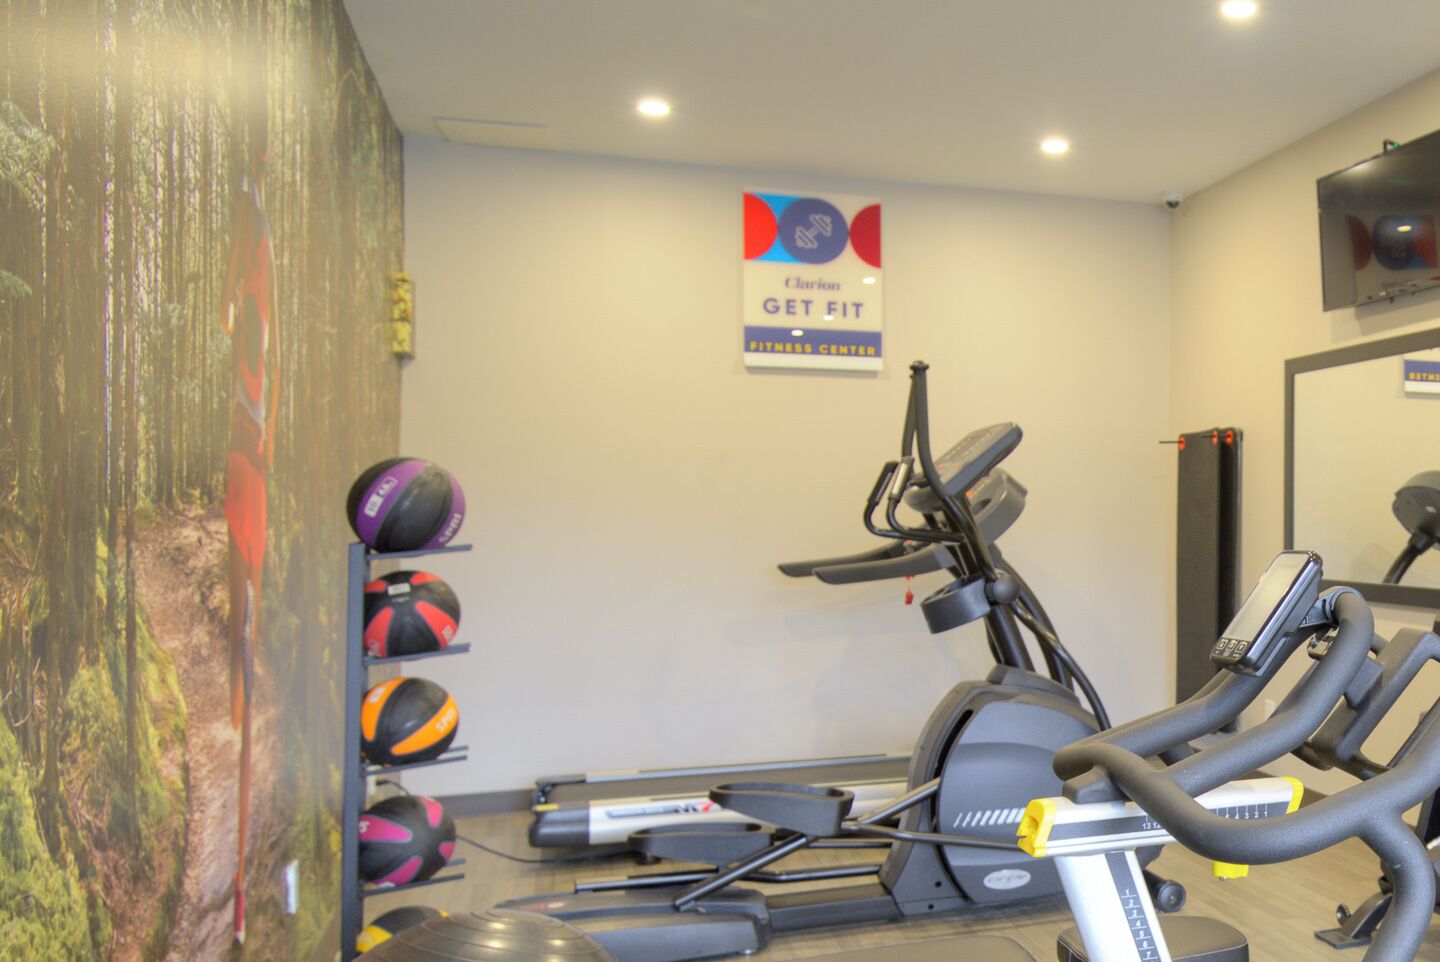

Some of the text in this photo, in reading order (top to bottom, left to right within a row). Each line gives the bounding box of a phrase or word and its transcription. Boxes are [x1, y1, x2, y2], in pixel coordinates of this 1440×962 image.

[784, 276, 840, 290] Clarion
[762, 298, 864, 318] GET FIT
[750, 342, 876, 356] FITNESS CENTER
